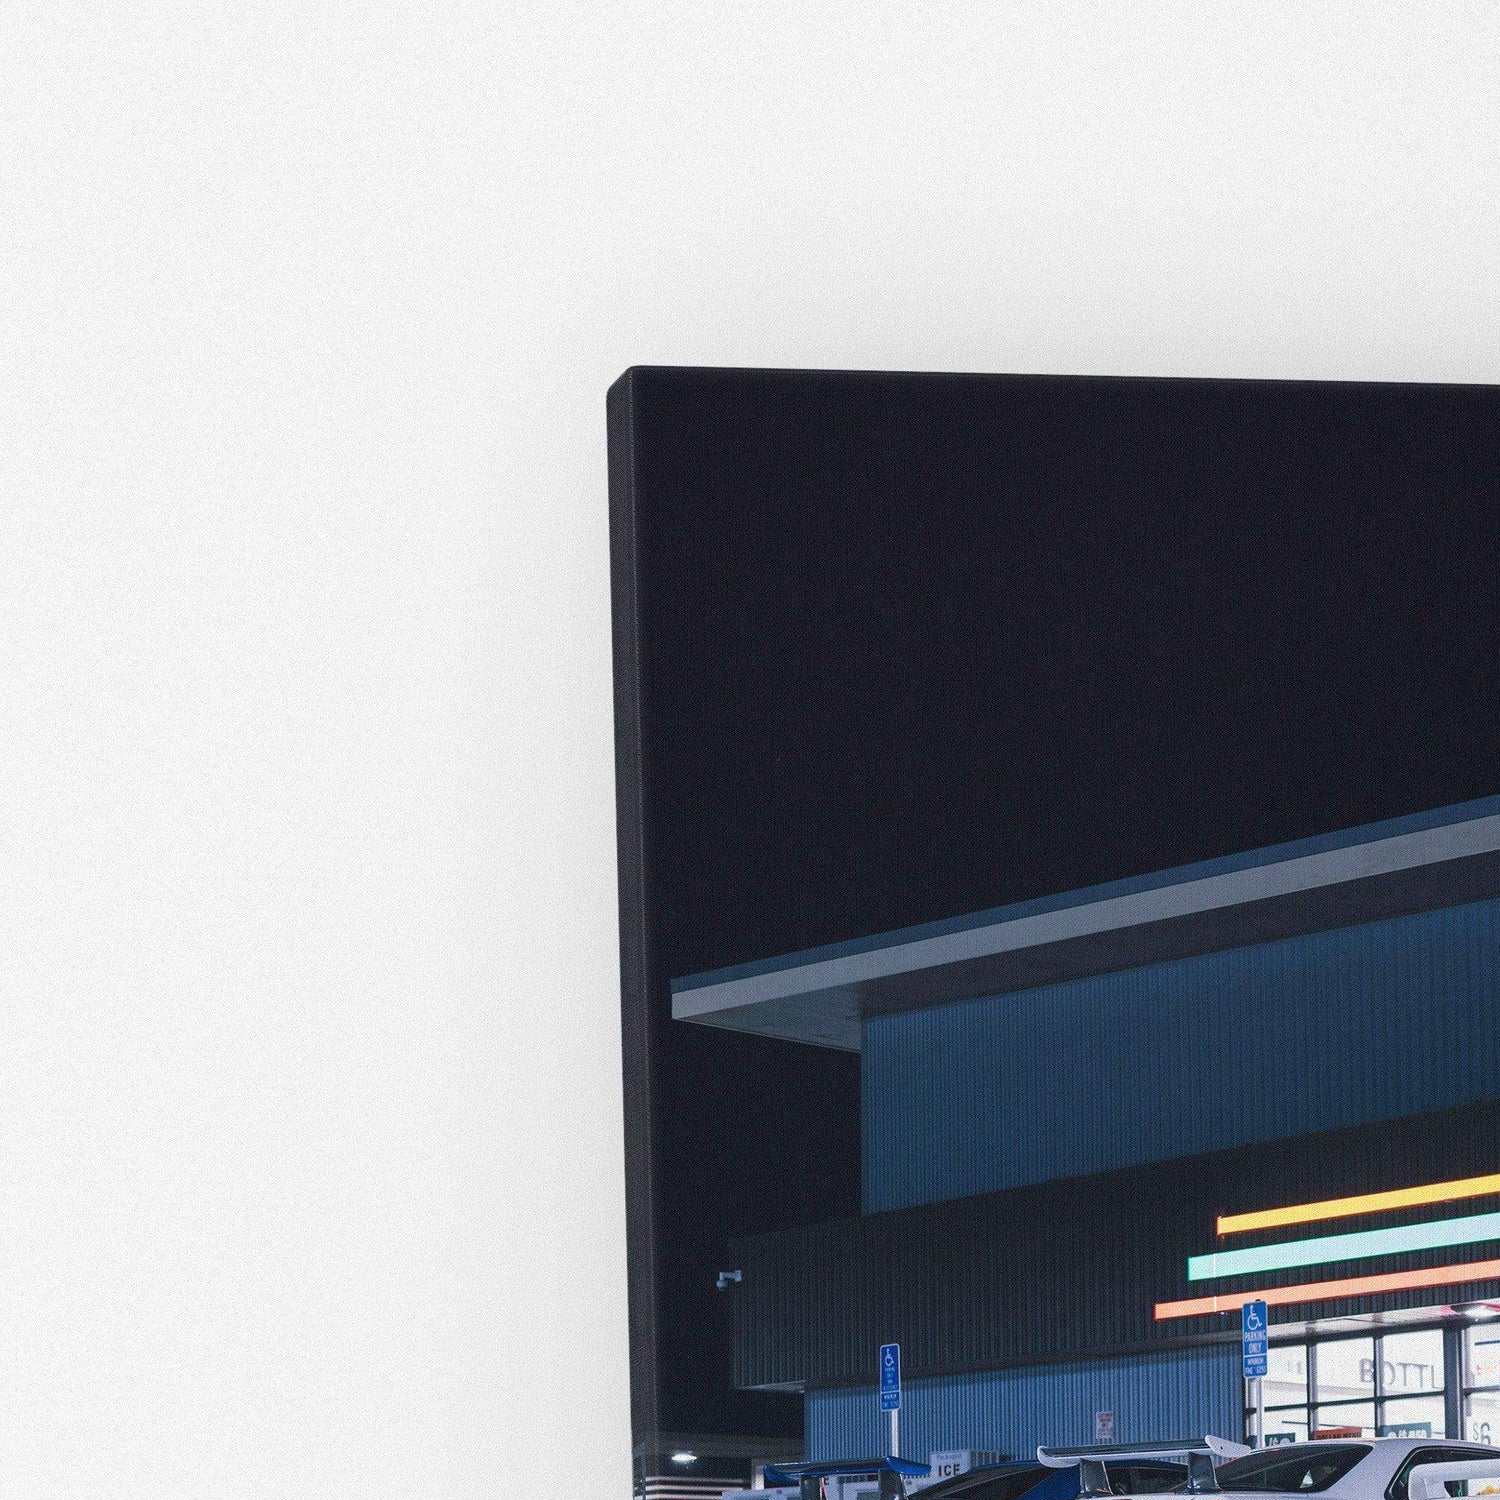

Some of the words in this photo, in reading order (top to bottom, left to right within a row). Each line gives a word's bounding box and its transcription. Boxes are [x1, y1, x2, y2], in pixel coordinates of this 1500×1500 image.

[1244, 1330, 1267, 1343] PARKING
[1249, 1342, 1262, 1354] ONLY
[938, 1463, 961, 1477] ICE
